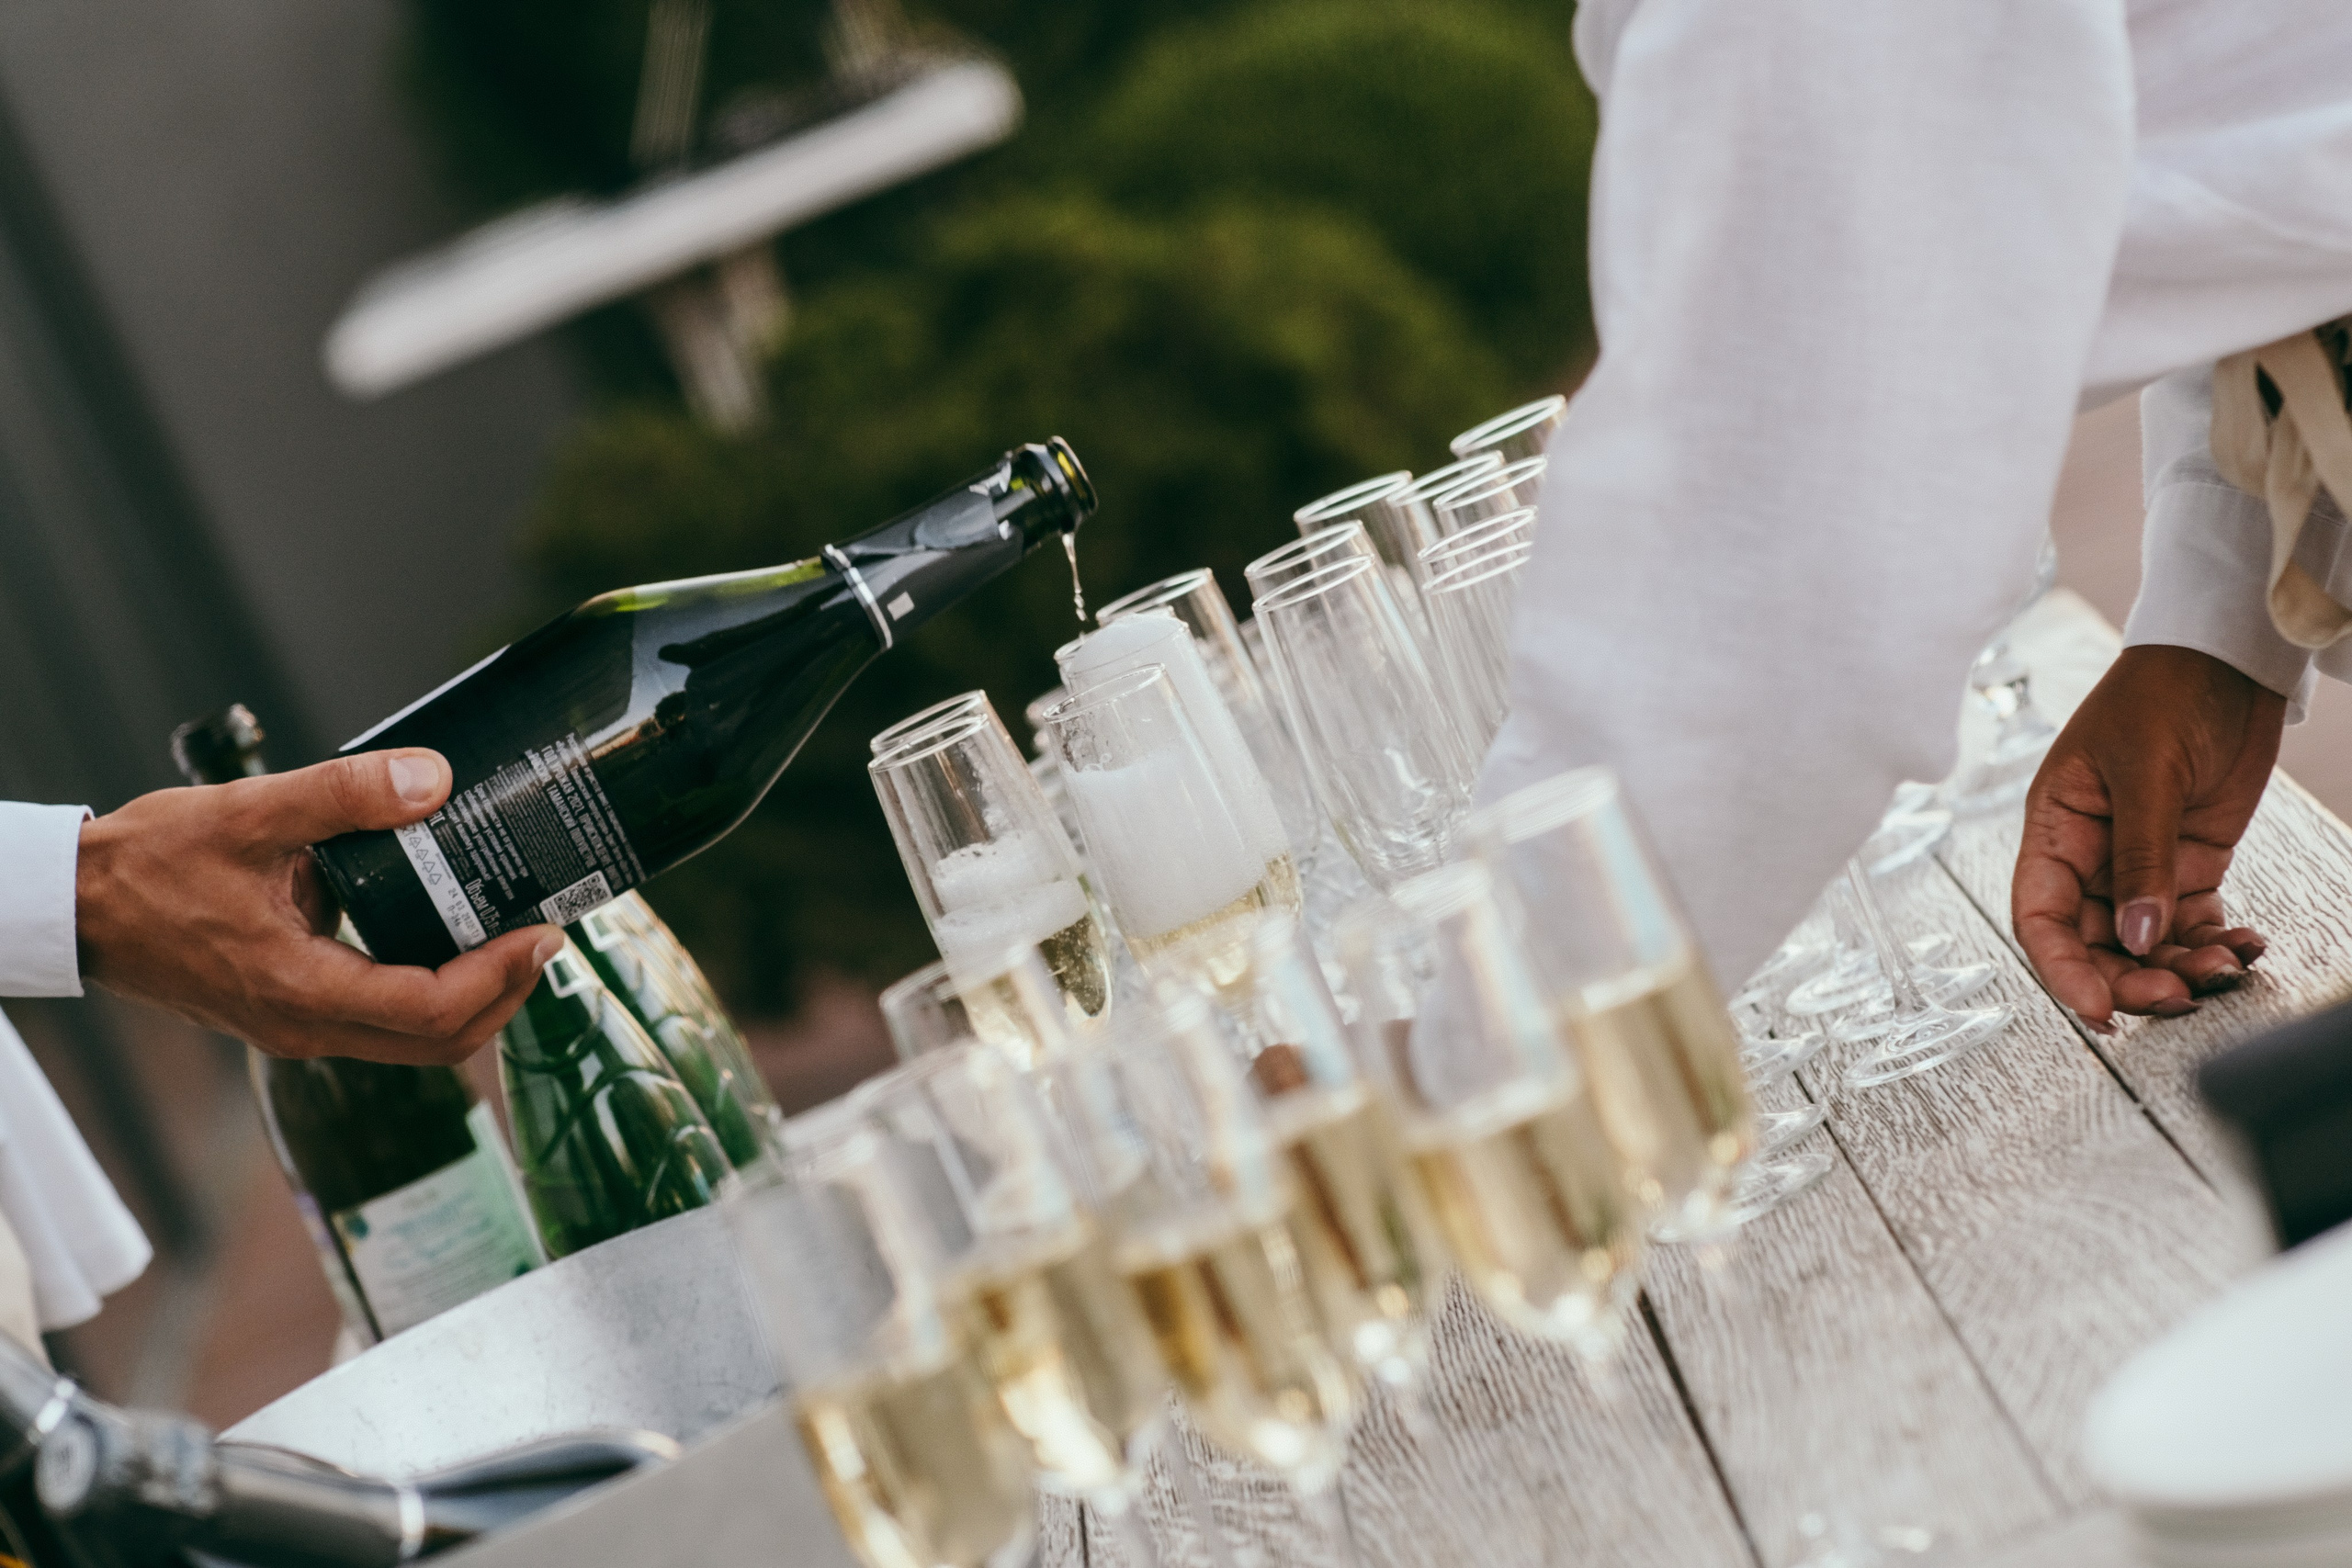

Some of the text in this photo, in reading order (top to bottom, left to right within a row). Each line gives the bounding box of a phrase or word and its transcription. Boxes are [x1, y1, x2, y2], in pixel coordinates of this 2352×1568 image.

[539, 744, 558, 764] ГОД
[548, 760, 575, 795] УРОЖАЯ
[471, 783, 489, 801] Срок
[497, 827, 506, 837] не
[545, 783, 579, 829] ТАМАНСКИЙ
[471, 832, 503, 876] употребление
[464, 877, 493, 911] Объем
[476, 905, 501, 927] 0,75
